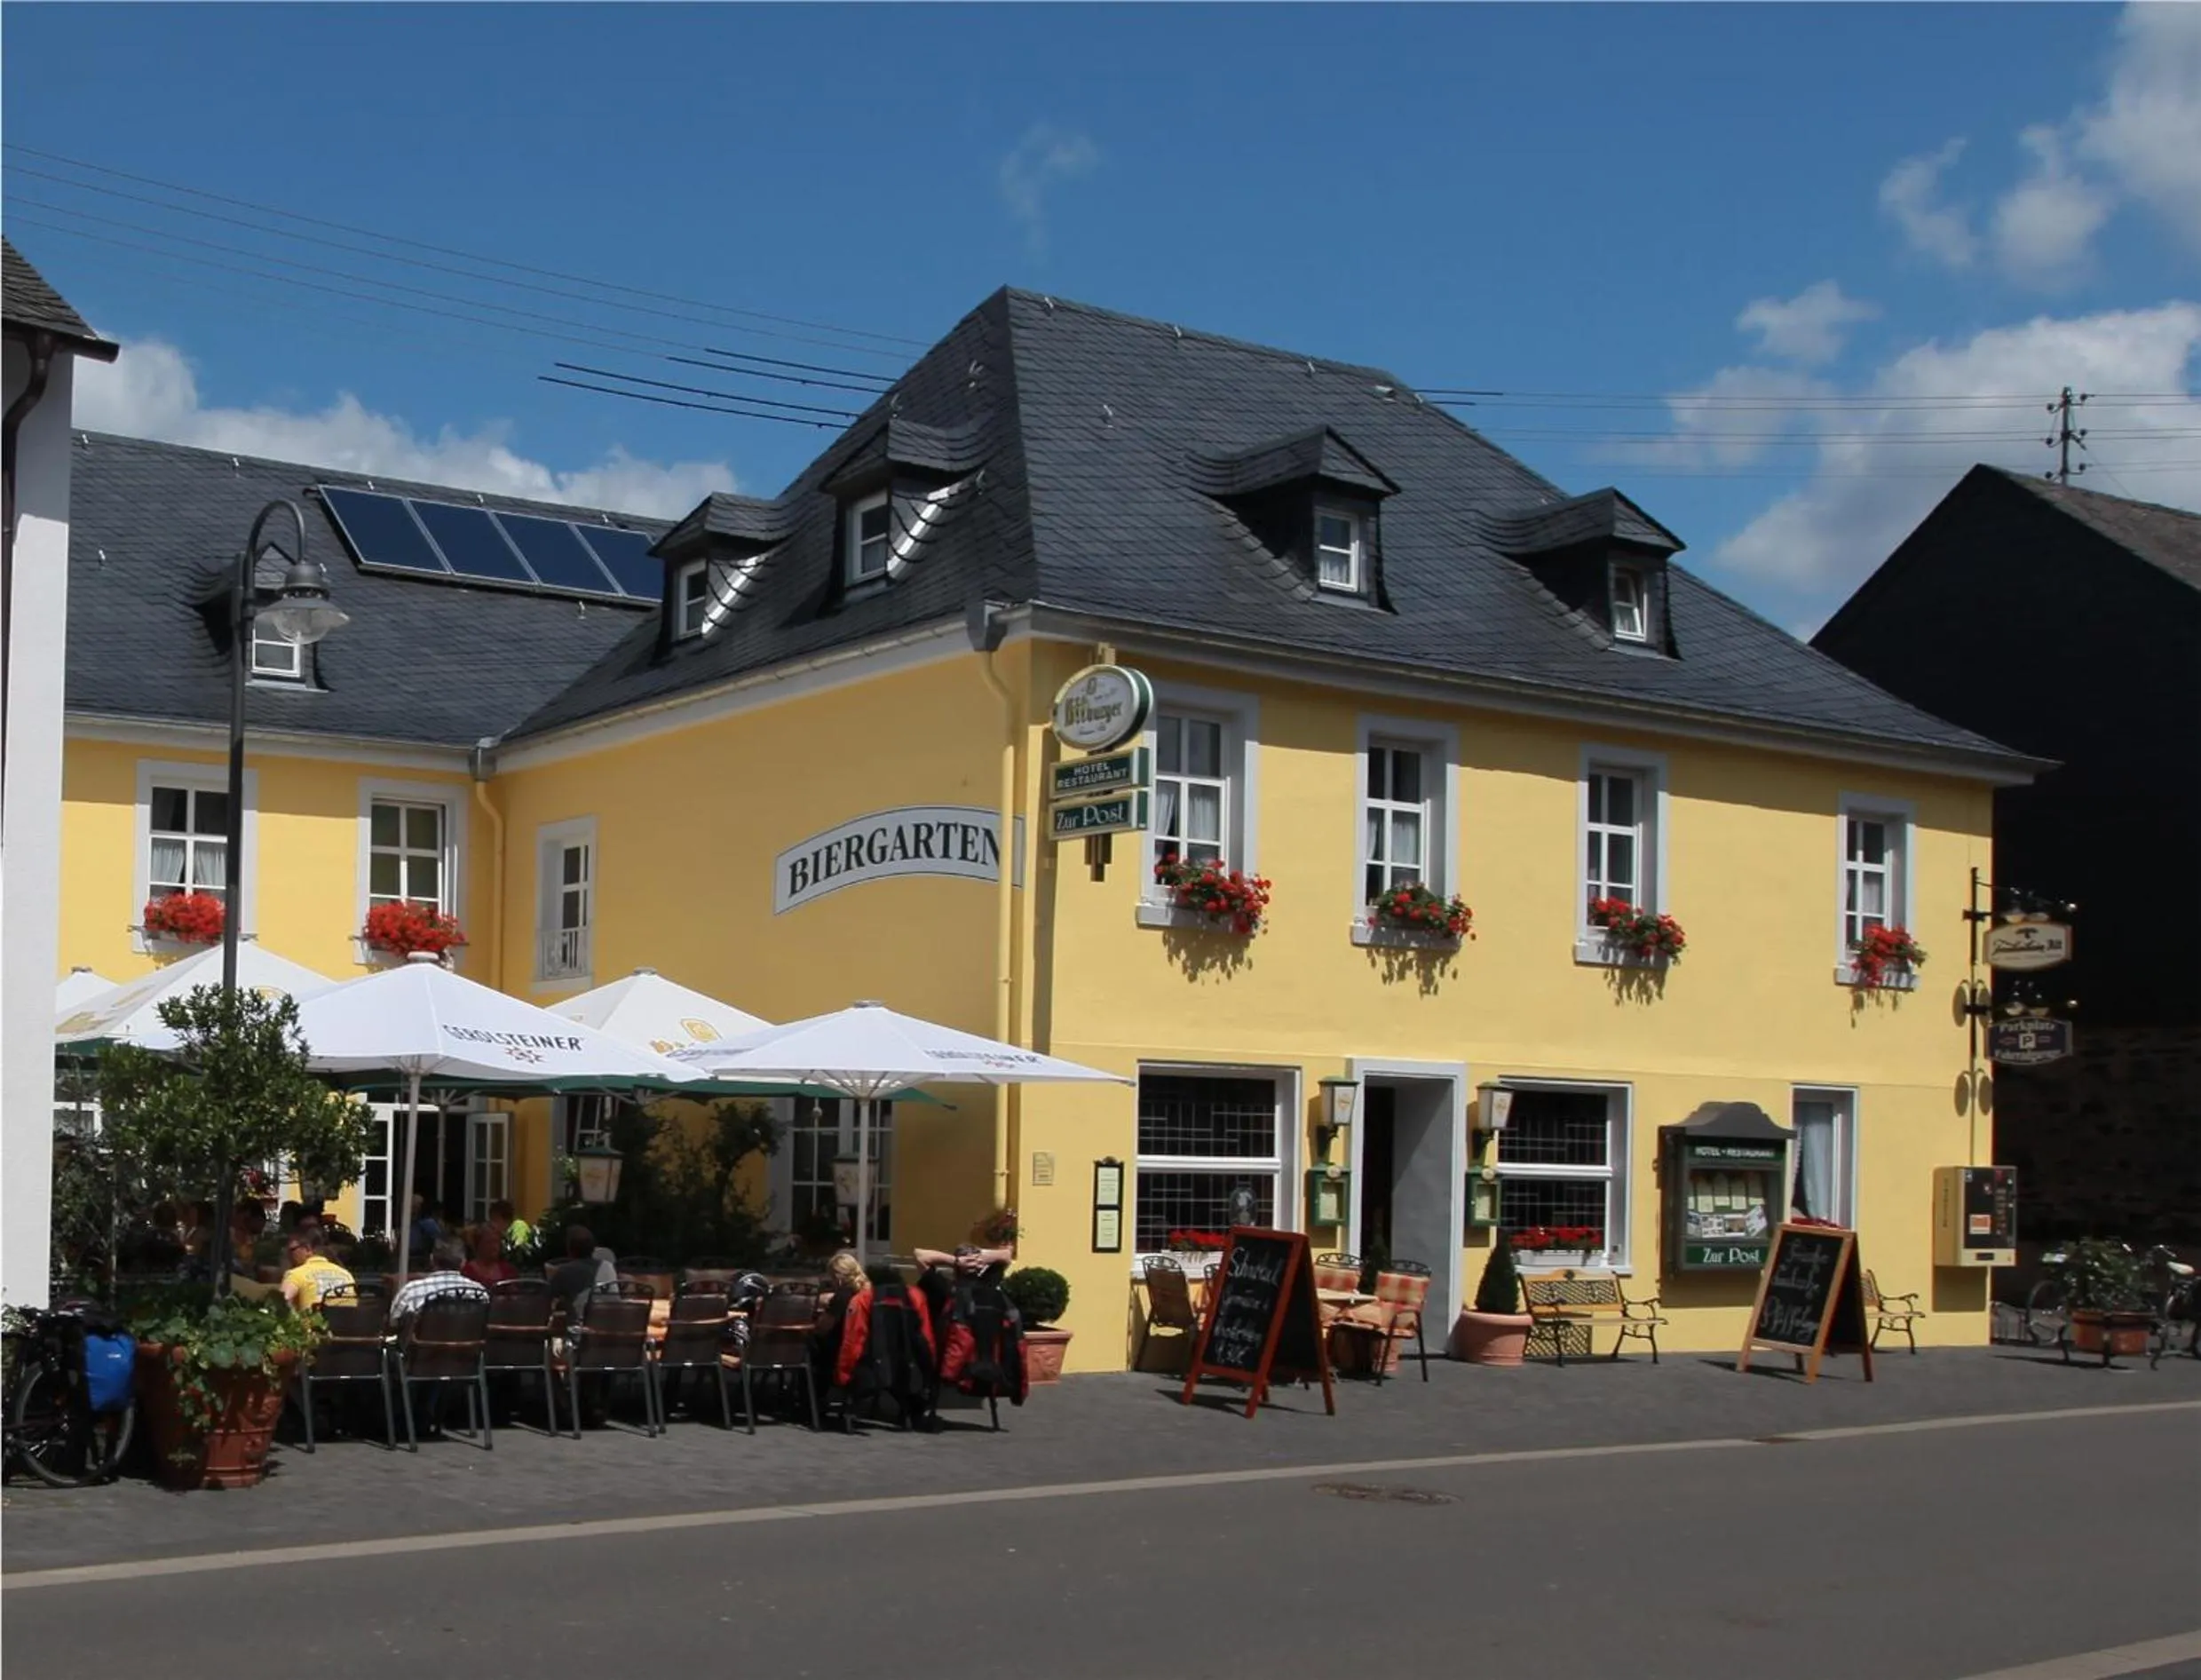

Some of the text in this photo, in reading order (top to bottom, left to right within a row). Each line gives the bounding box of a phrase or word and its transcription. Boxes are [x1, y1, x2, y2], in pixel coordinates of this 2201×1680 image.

[1057, 767, 1127, 788] RESTAURANT
[1073, 762, 1110, 775] HOTEL
[1057, 803, 1123, 829] Zur Post
[788, 821, 1001, 898] BIERGARTEN
[442, 1024, 582, 1050] GEROLSTEINER
[1703, 1247, 1761, 1263] Zur Post
